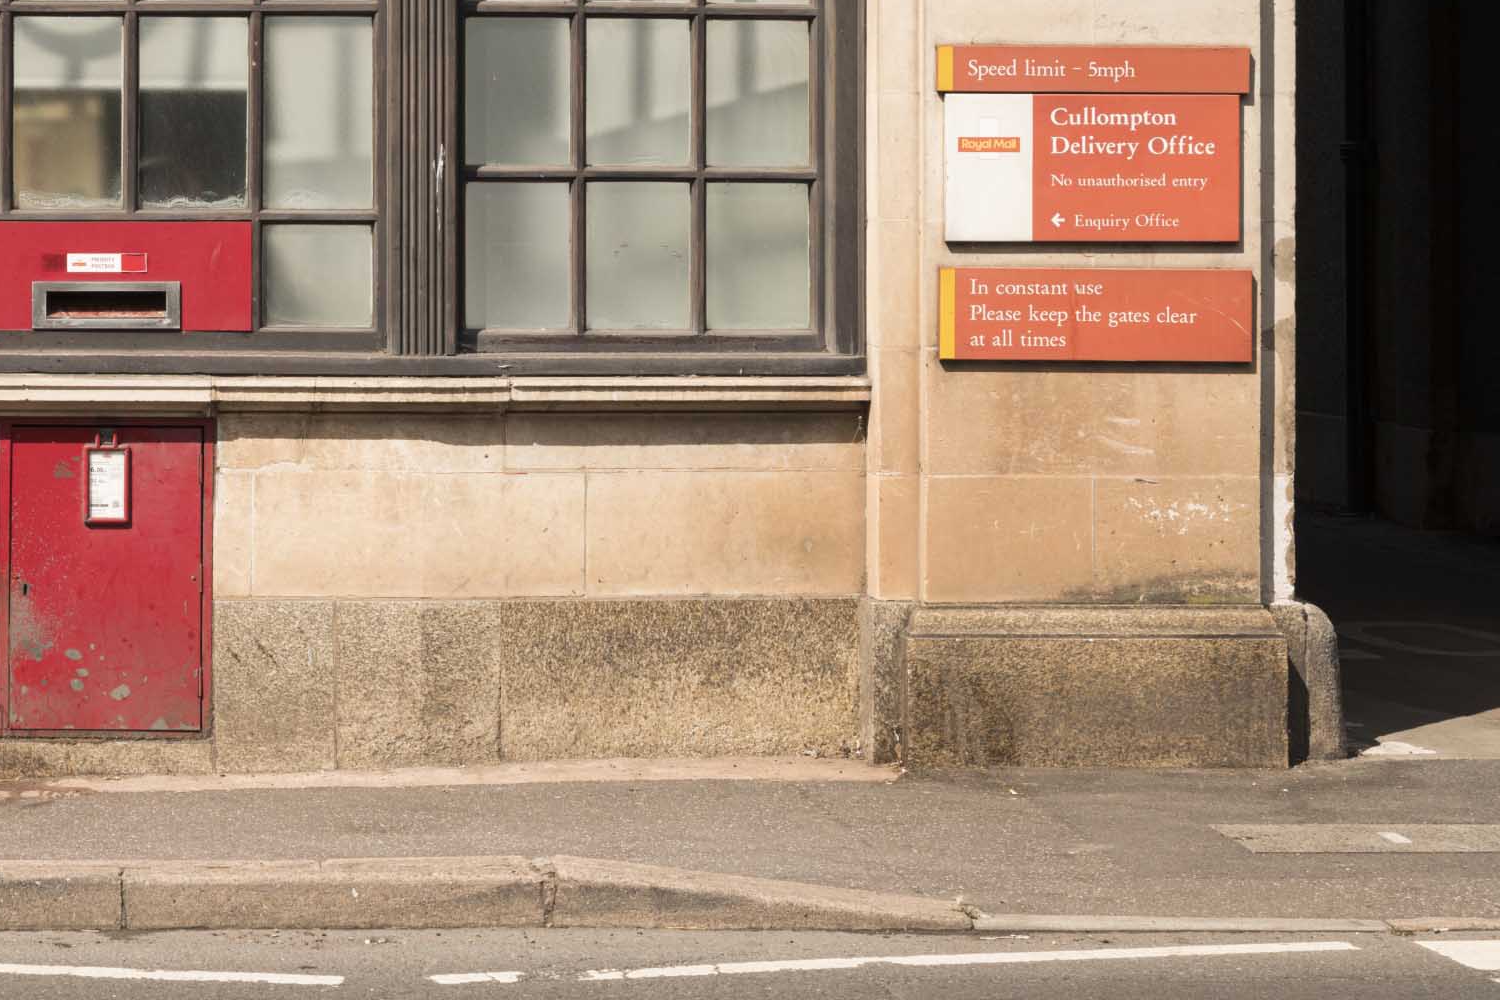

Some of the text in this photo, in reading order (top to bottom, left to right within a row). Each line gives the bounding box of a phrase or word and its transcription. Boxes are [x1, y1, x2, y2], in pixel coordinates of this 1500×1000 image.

[968, 58, 1016, 81] Speed
[1025, 58, 1065, 77] limit
[1089, 59, 1134, 84] 5mph
[1051, 106, 1176, 132] Cullompton
[962, 138, 1017, 151] Royal Mail
[1051, 135, 1215, 161] Delivery Office
[1051, 172, 1207, 191] No unauthorised entry
[1076, 213, 1179, 231] Enquiry Office
[971, 278, 1102, 296] In constant use
[970, 303, 1196, 328] Please keep the gates clear
[970, 329, 1066, 347] at all times
